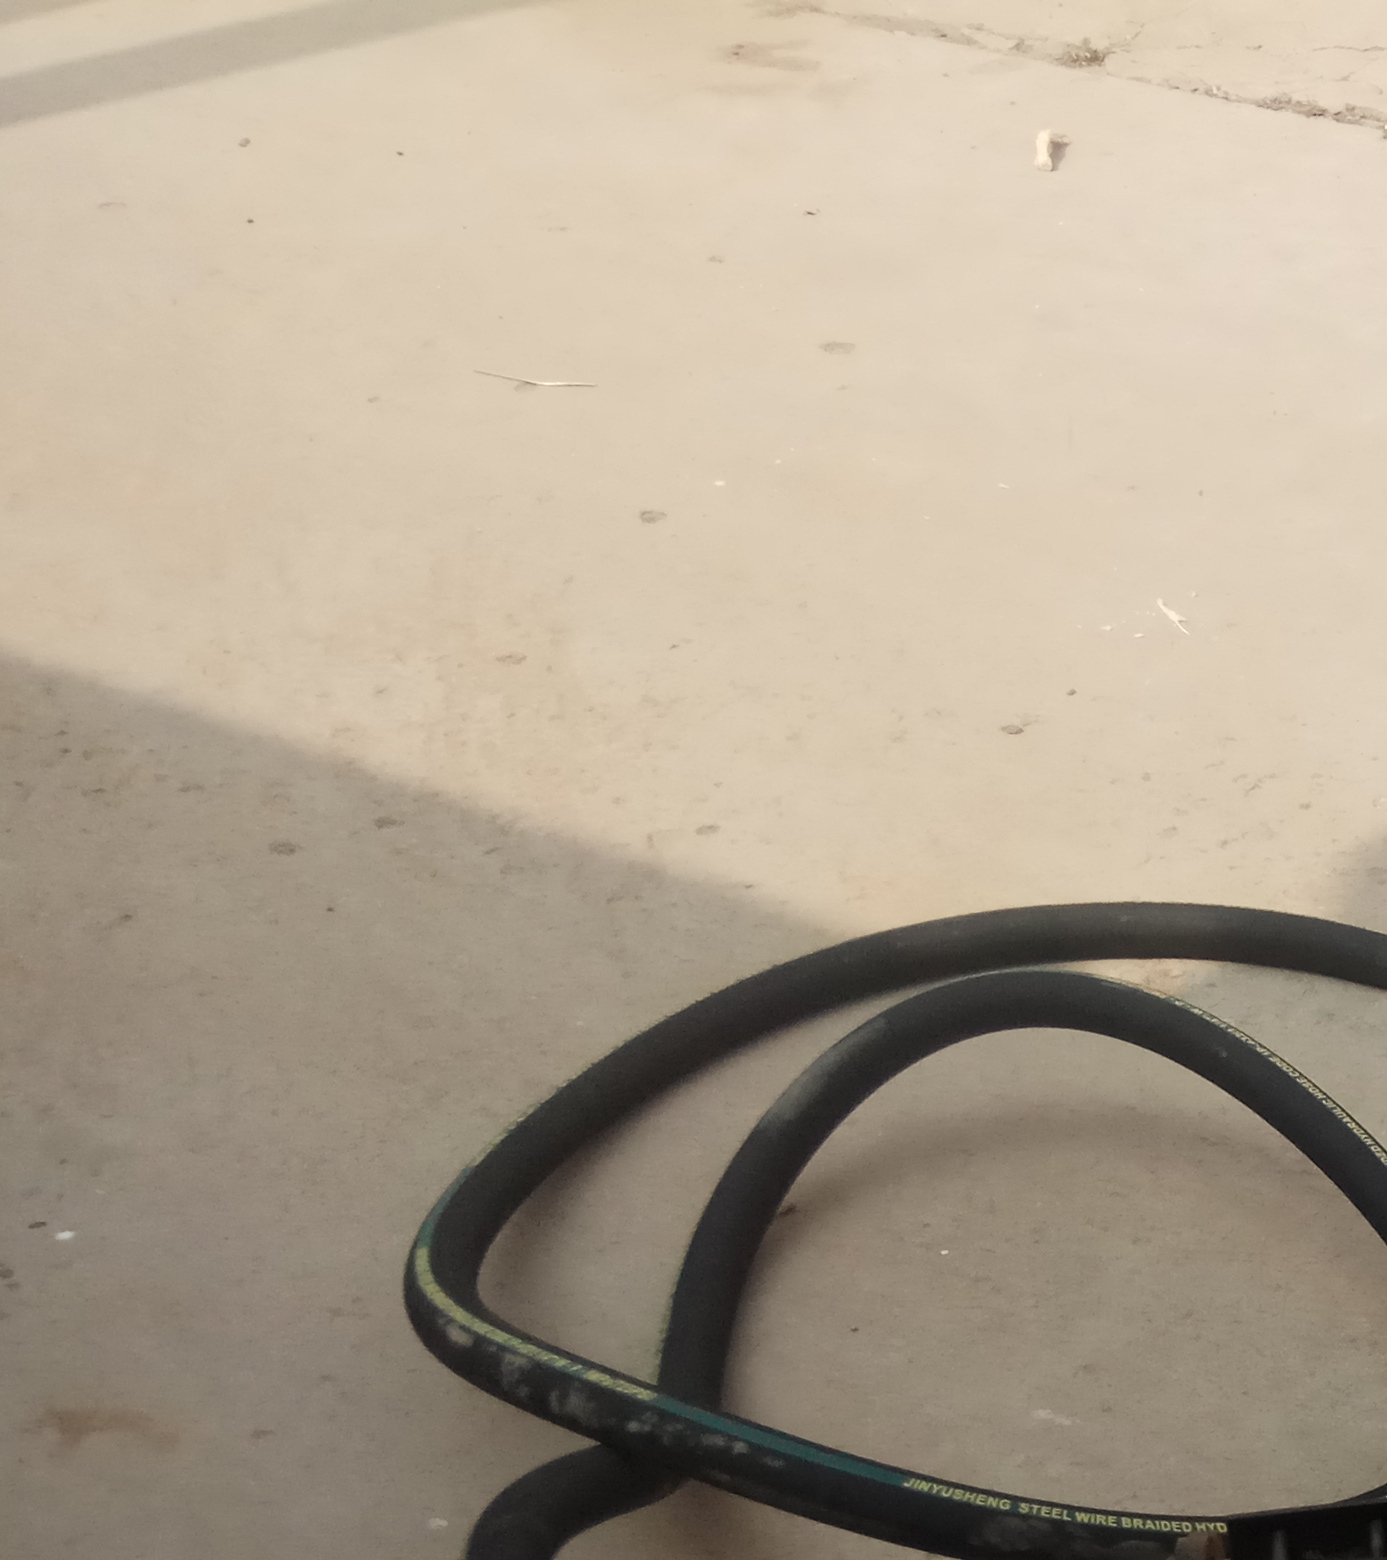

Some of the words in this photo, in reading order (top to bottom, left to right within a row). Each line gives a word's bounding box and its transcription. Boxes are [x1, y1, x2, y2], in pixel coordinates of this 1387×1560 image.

[903, 1477, 1012, 1511] JINYUSHENG
[1018, 1502, 1072, 1521] STEEL
[1075, 1511, 1119, 1527] WIRE
[1121, 1516, 1192, 1533] BRAIDED
